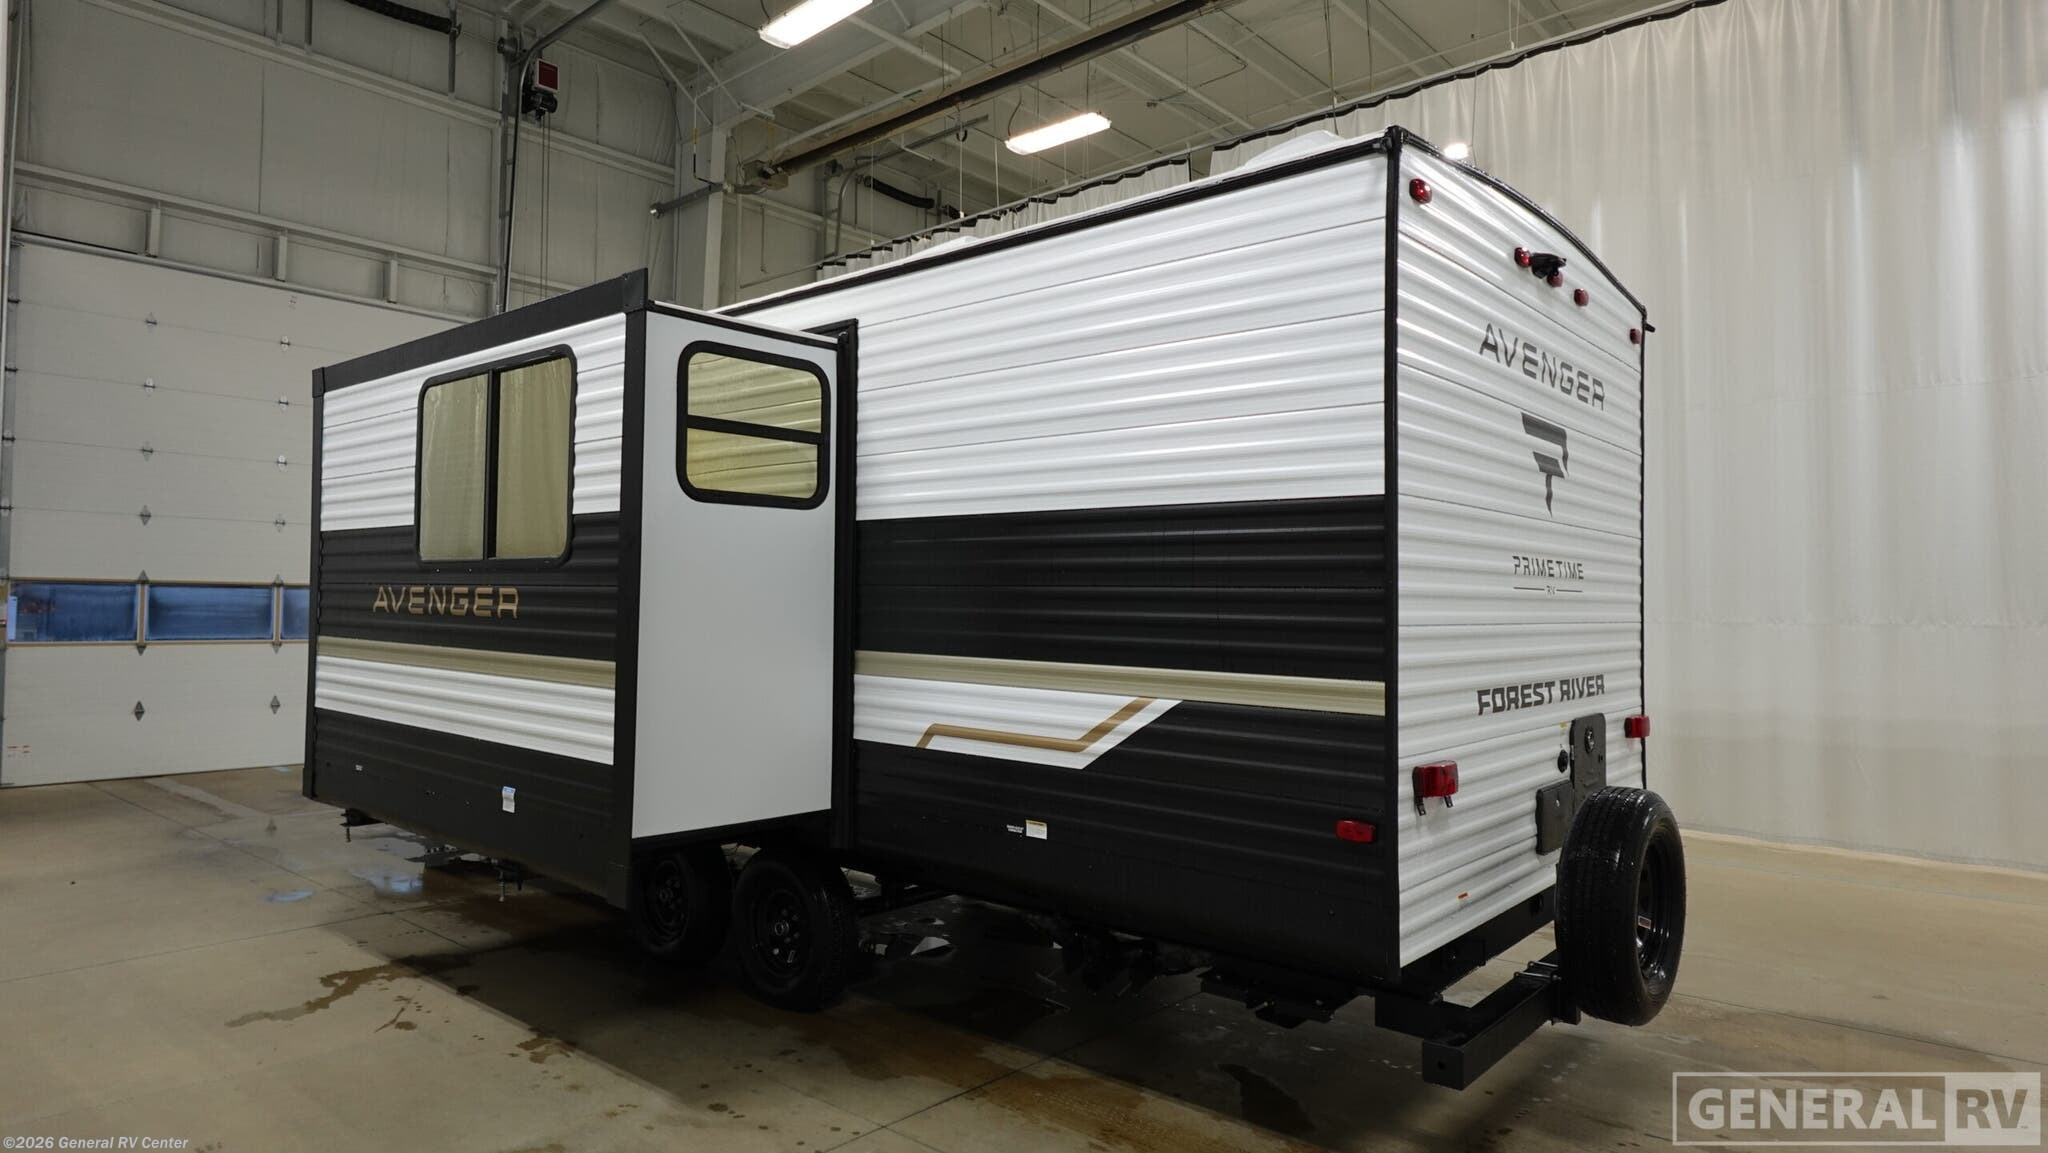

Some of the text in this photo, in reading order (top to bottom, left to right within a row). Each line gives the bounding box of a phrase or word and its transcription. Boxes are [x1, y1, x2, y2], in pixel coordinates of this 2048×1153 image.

[1479, 323, 1605, 411] AVENGER
[1512, 556, 1584, 581] PRIMETIME
[372, 585, 519, 619] AVENGER
[1477, 674, 1605, 716] FOREST RIVER
